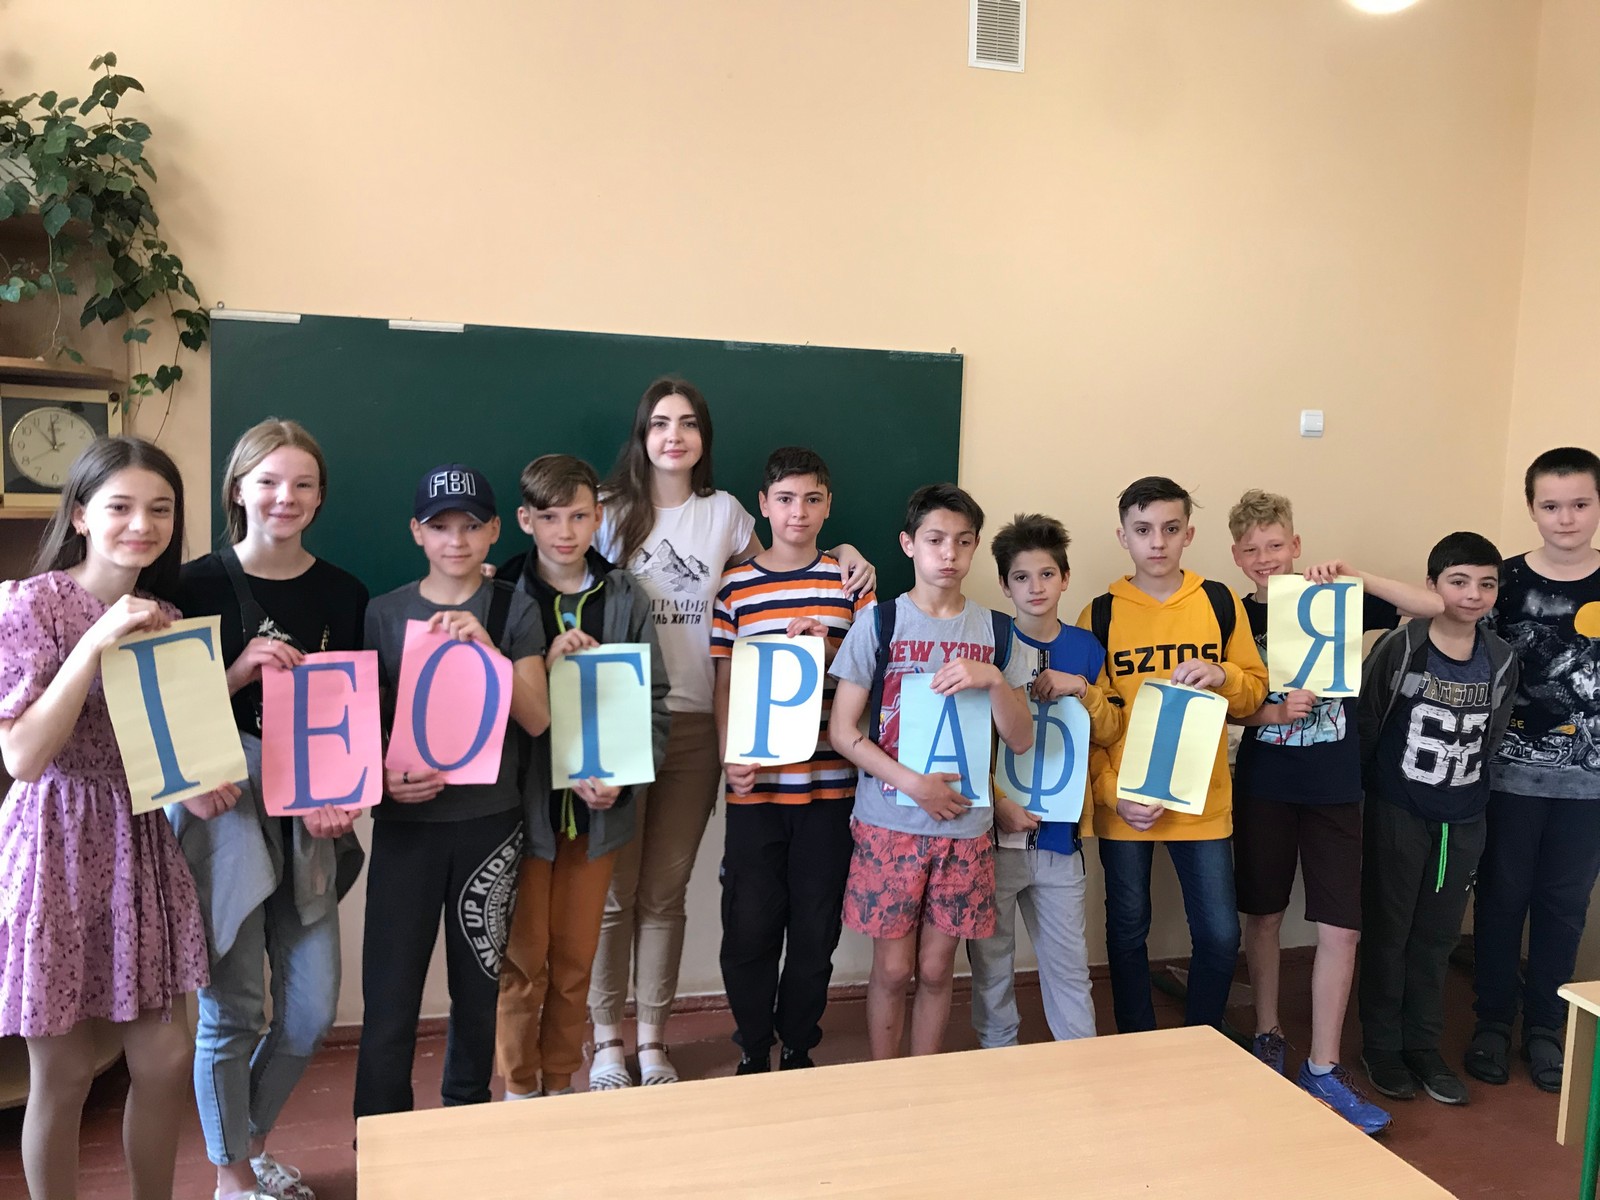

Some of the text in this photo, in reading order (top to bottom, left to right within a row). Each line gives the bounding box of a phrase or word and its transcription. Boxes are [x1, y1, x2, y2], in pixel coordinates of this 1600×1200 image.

[17, 440, 26, 450] 9
[21, 426, 32, 436] 10
[79, 429, 87, 440] 2
[34, 466, 42, 477] 7
[51, 472, 60, 482] 6
[429, 470, 476, 498] FBI
[651, 599, 709, 613] ГРАФІЯ
[652, 613, 702, 625] ЛЬ ЖИТТЯ
[939, 641, 995, 664] YORK
[1283, 582, 1358, 693] Я
[1113, 643, 1219, 677] SZTOS
[118, 626, 217, 801] Г
[411, 639, 501, 772] О
[738, 641, 819, 759] Р
[565, 652, 646, 780] Г
[1509, 718, 1525, 729] SE
[282, 661, 369, 811] Е
[923, 693, 981, 800] А
[1400, 701, 1490, 787] 62
[1004, 698, 1076, 814] Ф
[470, 845, 515, 896] KIDS
[464, 900, 484, 928] UP
